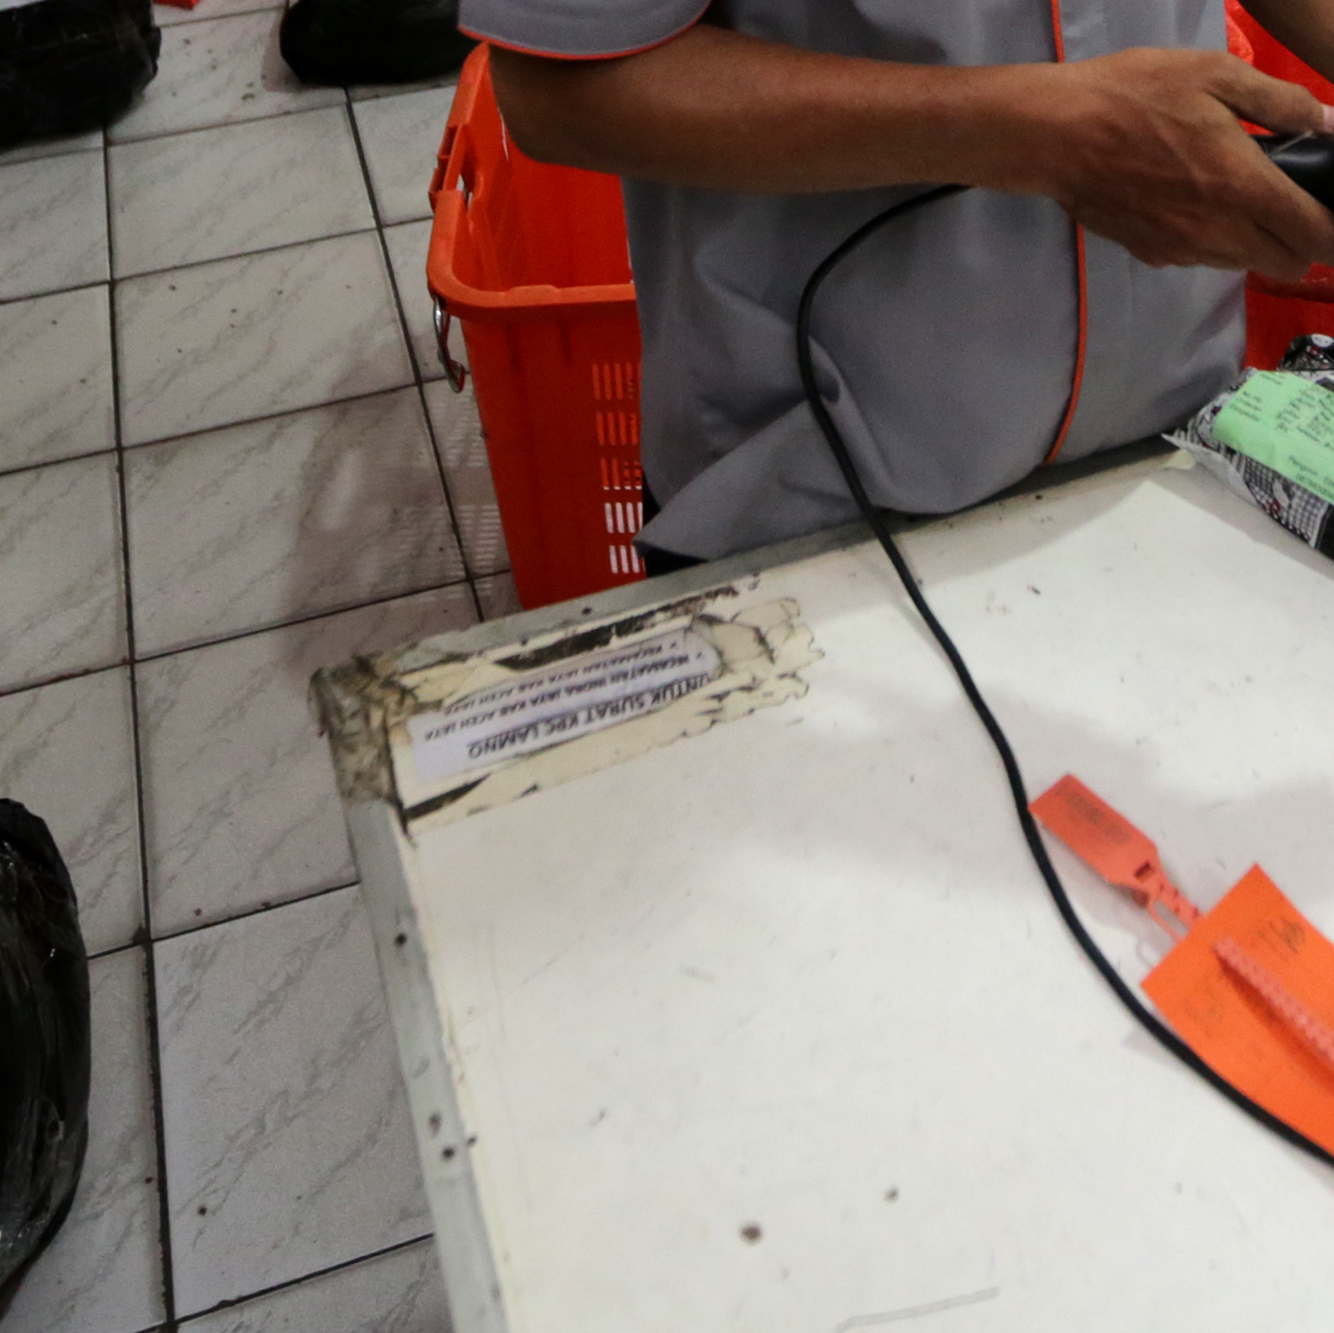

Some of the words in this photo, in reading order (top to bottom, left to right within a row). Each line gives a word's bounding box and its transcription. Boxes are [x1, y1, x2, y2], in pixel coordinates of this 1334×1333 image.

[583, 645, 661, 674] KECAMATAN
[612, 654, 688, 686] KECAMATAN
[516, 678, 543, 695] KAB
[548, 667, 578, 686] JAYA
[480, 688, 513, 707] ACEH
[531, 688, 561, 708] JAYA
[500, 699, 526, 718] KAB
[585, 695, 643, 724] SURAT
[461, 709, 495, 731] ACEH
[544, 712, 578, 736] KPC
[425, 722, 455, 742] JAYA
[468, 723, 539, 759] LAMNO
